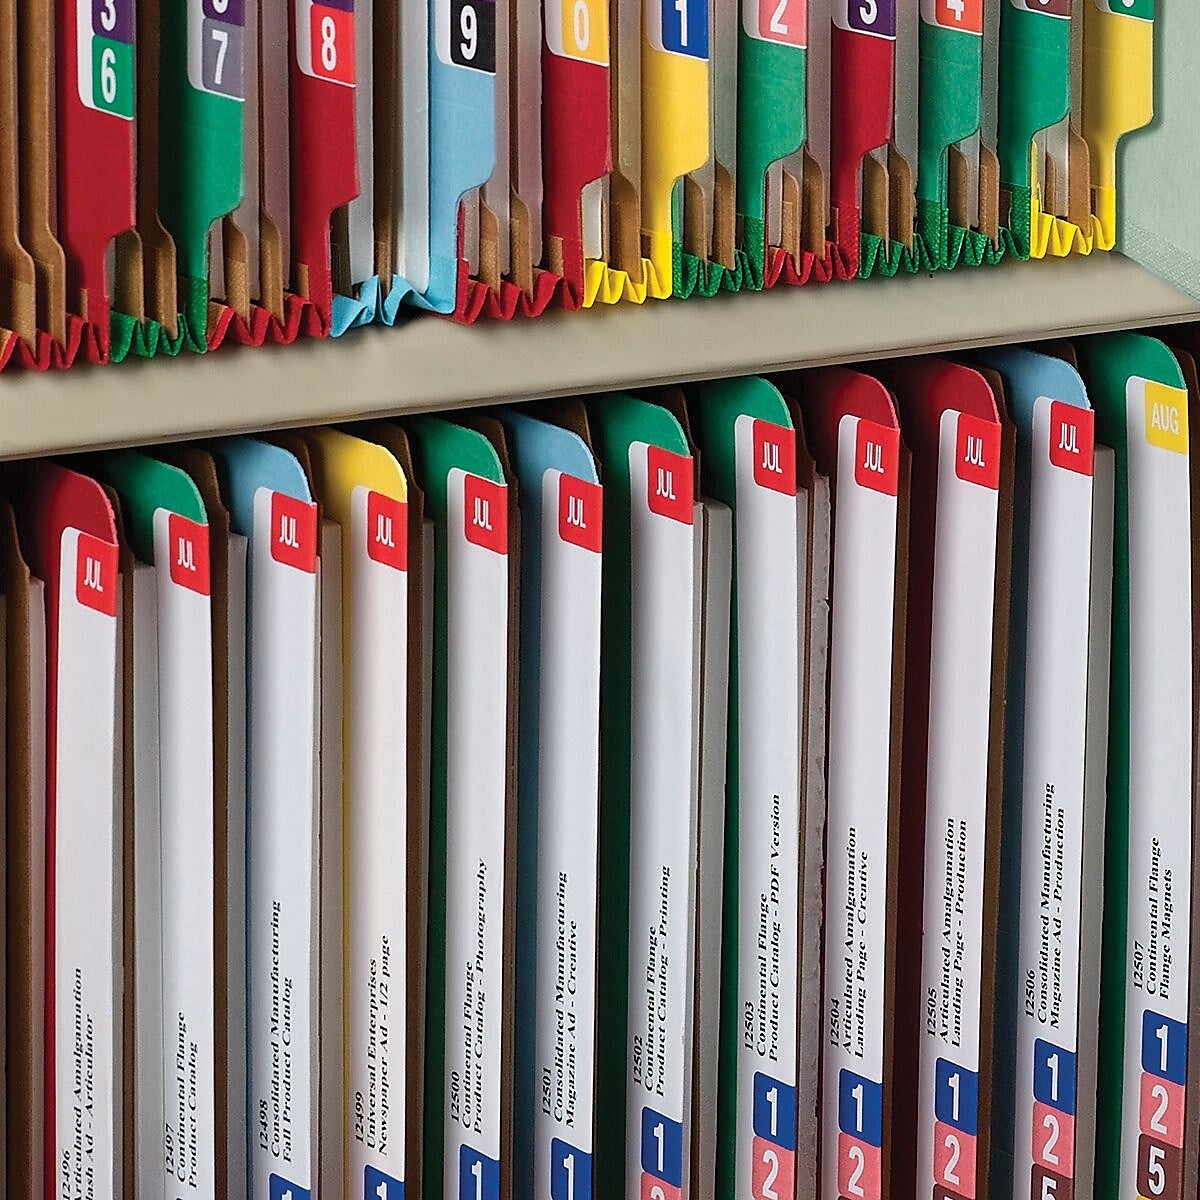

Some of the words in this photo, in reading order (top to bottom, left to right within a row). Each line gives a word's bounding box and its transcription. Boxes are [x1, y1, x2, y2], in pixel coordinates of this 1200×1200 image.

[1151, 406, 1179, 435] AUG
[762, 442, 783, 474] JUL
[964, 434, 985, 467] JUL
[280, 514, 299, 549] JUL
[473, 497, 492, 531] JUL
[84, 557, 103, 592] JUL
[942, 818, 954, 943] Amalgamation
[1149, 838, 1161, 892] Flange
[1161, 869, 1174, 940] Magnets
[270, 901, 280, 1036] Manufacturing
[1133, 940, 1144, 990] 12507
[1145, 897, 1158, 994] Continental
[1159, 945, 1172, 999] Flange
[282, 977, 292, 1046] Catalog
[927, 987, 938, 1037] 12505
[938, 947, 951, 1043] Articulated
[177, 1012, 186, 1071] Flange
[188, 1042, 197, 1111] Catalog
[270, 1041, 280, 1157] Consolidated
[283, 1052, 291, 1123] Product
[166, 1123, 175, 1176] 12497
[177, 1076, 185, 1182] Continental
[189, 1116, 197, 1188] Product
[258, 1099, 269, 1152] 12498
[283, 1128, 291, 1162] Fall
